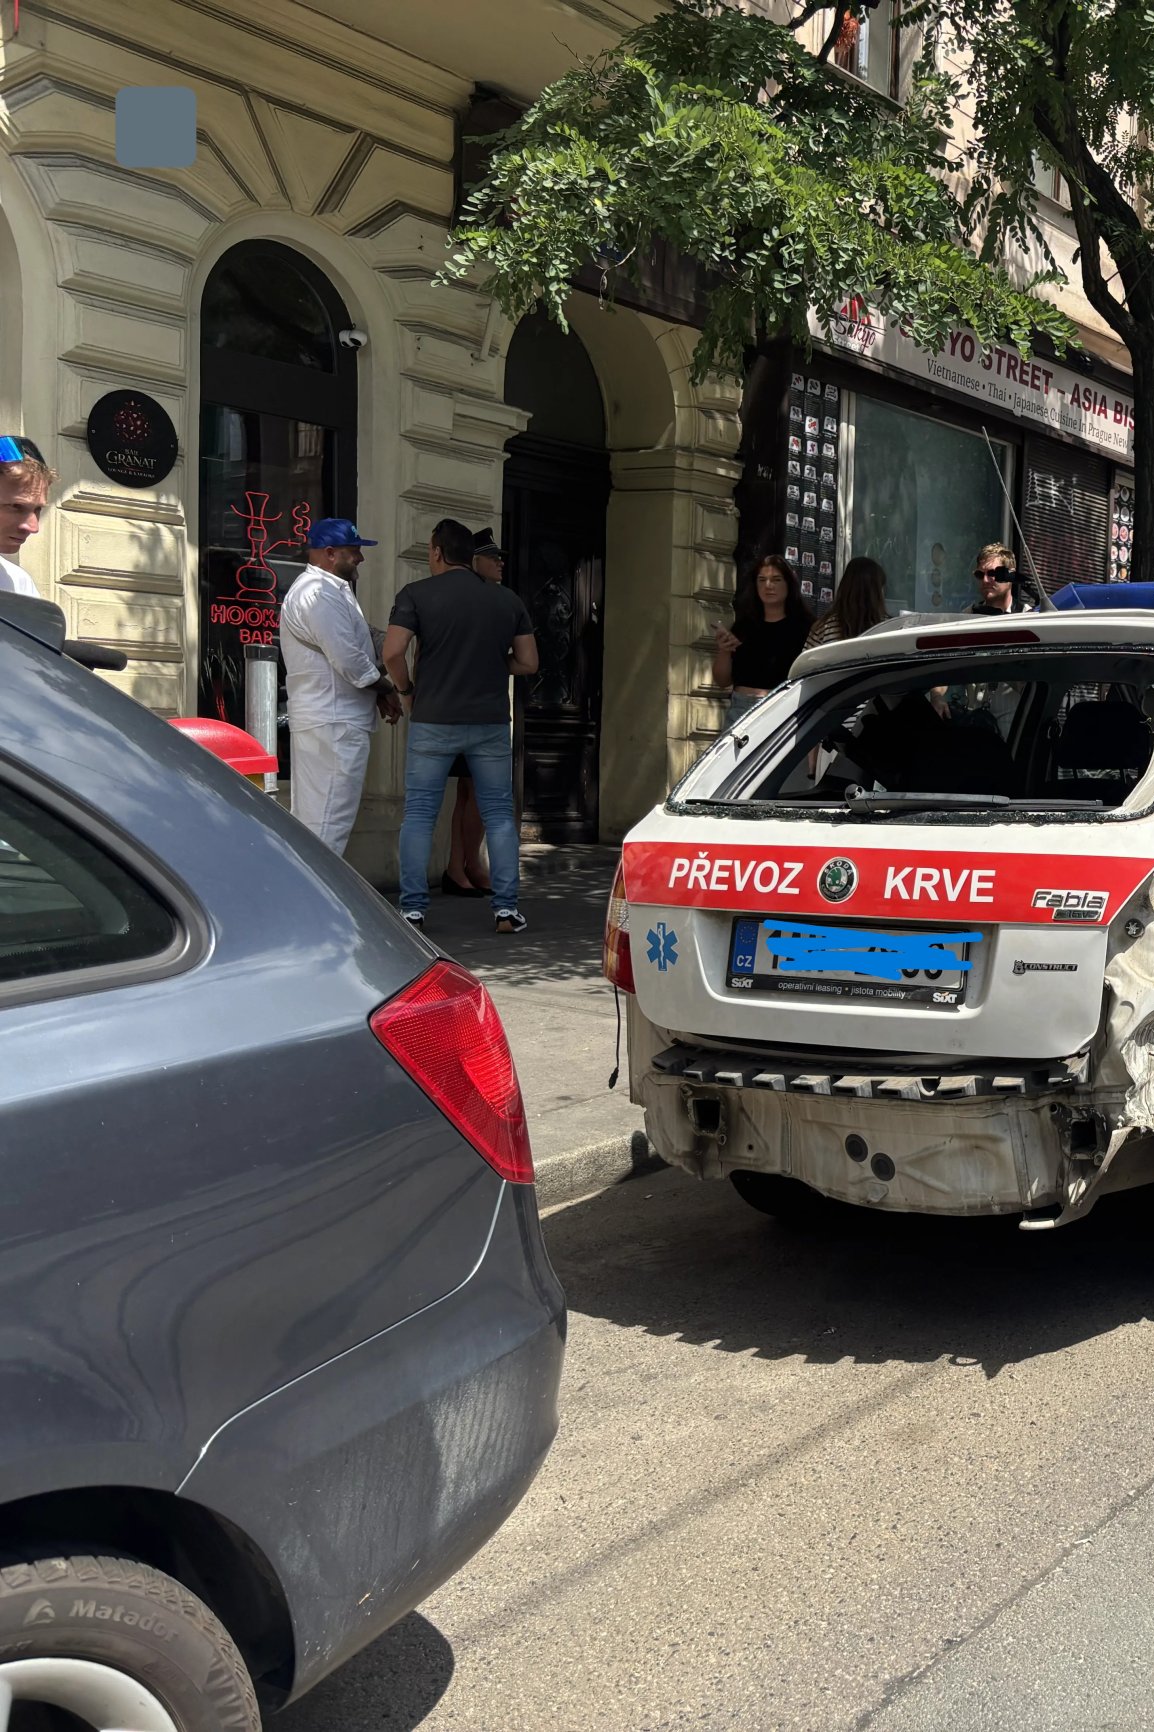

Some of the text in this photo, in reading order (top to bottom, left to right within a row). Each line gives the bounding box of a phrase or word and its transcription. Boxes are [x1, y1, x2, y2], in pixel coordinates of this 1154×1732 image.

[979, 344, 1054, 396] STREET
[1070, 383, 1108, 420] ASIA
[926, 358, 980, 392] Vietnamese
[987, 382, 1007, 403] Thai
[1013, 392, 1049, 417] Japanese
[1050, 407, 1078, 430] Cuisine
[1079, 419, 1087, 435] In
[1088, 422, 1112, 443] Prague
[105, 450, 157, 470] GRANAT
[239, 628, 274, 645] BAR
[668, 852, 996, 903] PŘEVOZ KRVE
[1033, 890, 1105, 909] Fabia
[736, 954, 753, 968] CZ
[1024, 962, 1078, 972] CONSTRUCT
[778, 981, 906, 1000] operativní leasing jistota mobility
[69, 1599, 179, 1642] Matador
